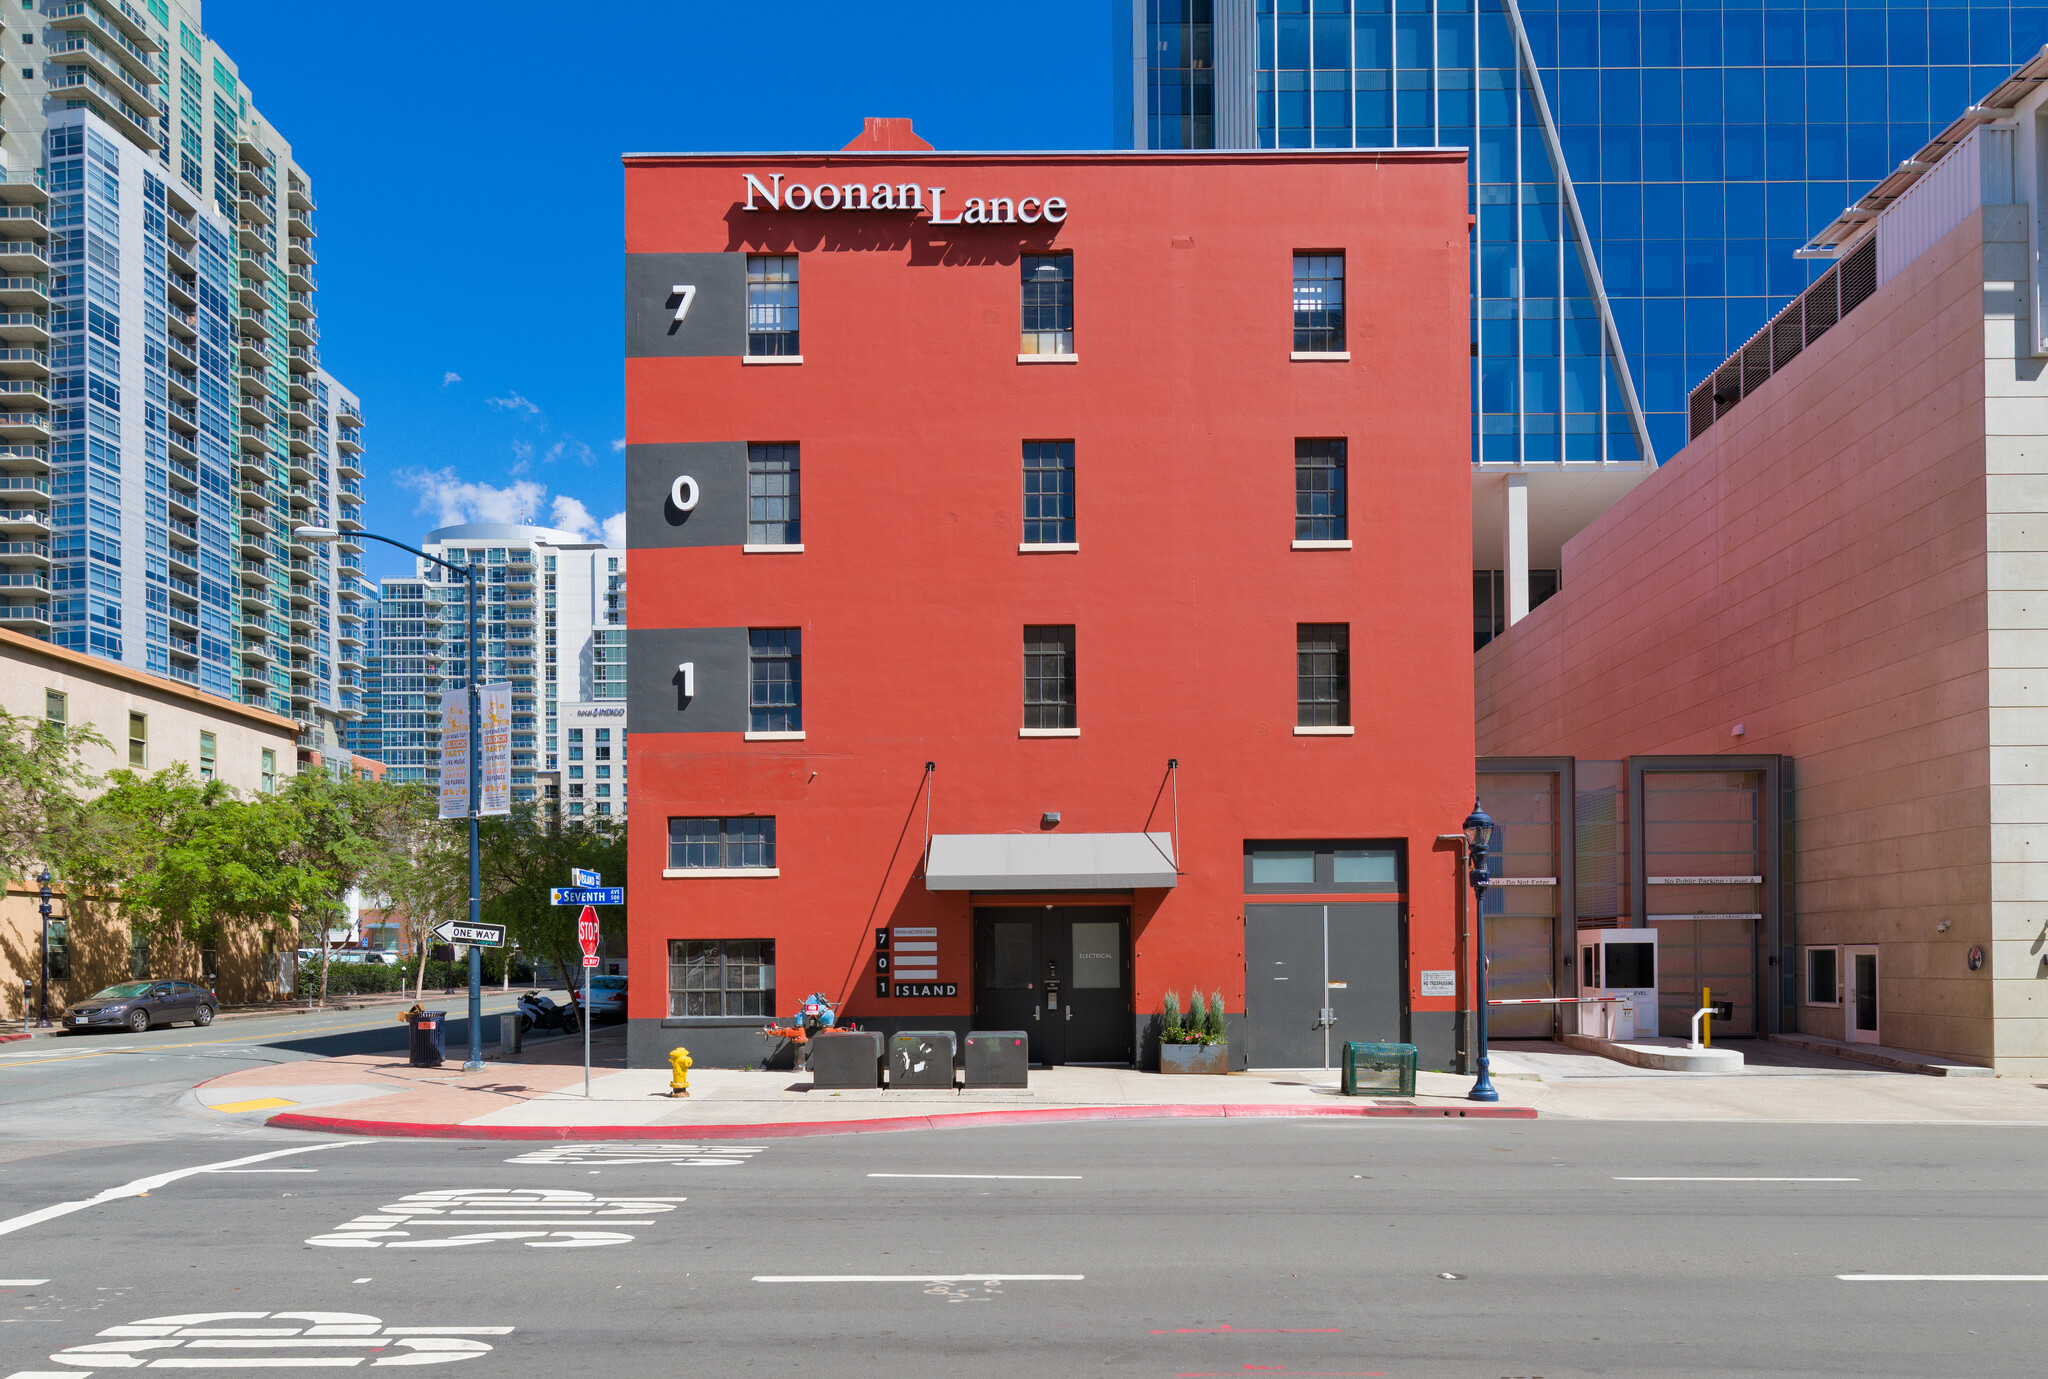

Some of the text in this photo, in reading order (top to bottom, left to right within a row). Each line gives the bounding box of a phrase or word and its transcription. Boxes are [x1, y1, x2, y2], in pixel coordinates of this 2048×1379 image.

[742, 173, 1068, 224] Noonan Lance
[672, 284, 696, 321] 7
[671, 475, 699, 511] 0
[679, 662, 695, 697] 1
[445, 740, 466, 749] BLOCK
[486, 735, 507, 744] BLOCK
[445, 750, 466, 758] PARTY
[485, 744, 506, 753] PARTY
[563, 891, 605, 902] SEVENTH
[453, 928, 496, 939] ONE WAY
[580, 921, 598, 941] STOP
[879, 933, 886, 944] 7
[879, 958, 887, 968] 0
[880, 983, 885, 992] 1
[896, 985, 956, 996] ISLAND
[304, 1188, 688, 1248] STOP
